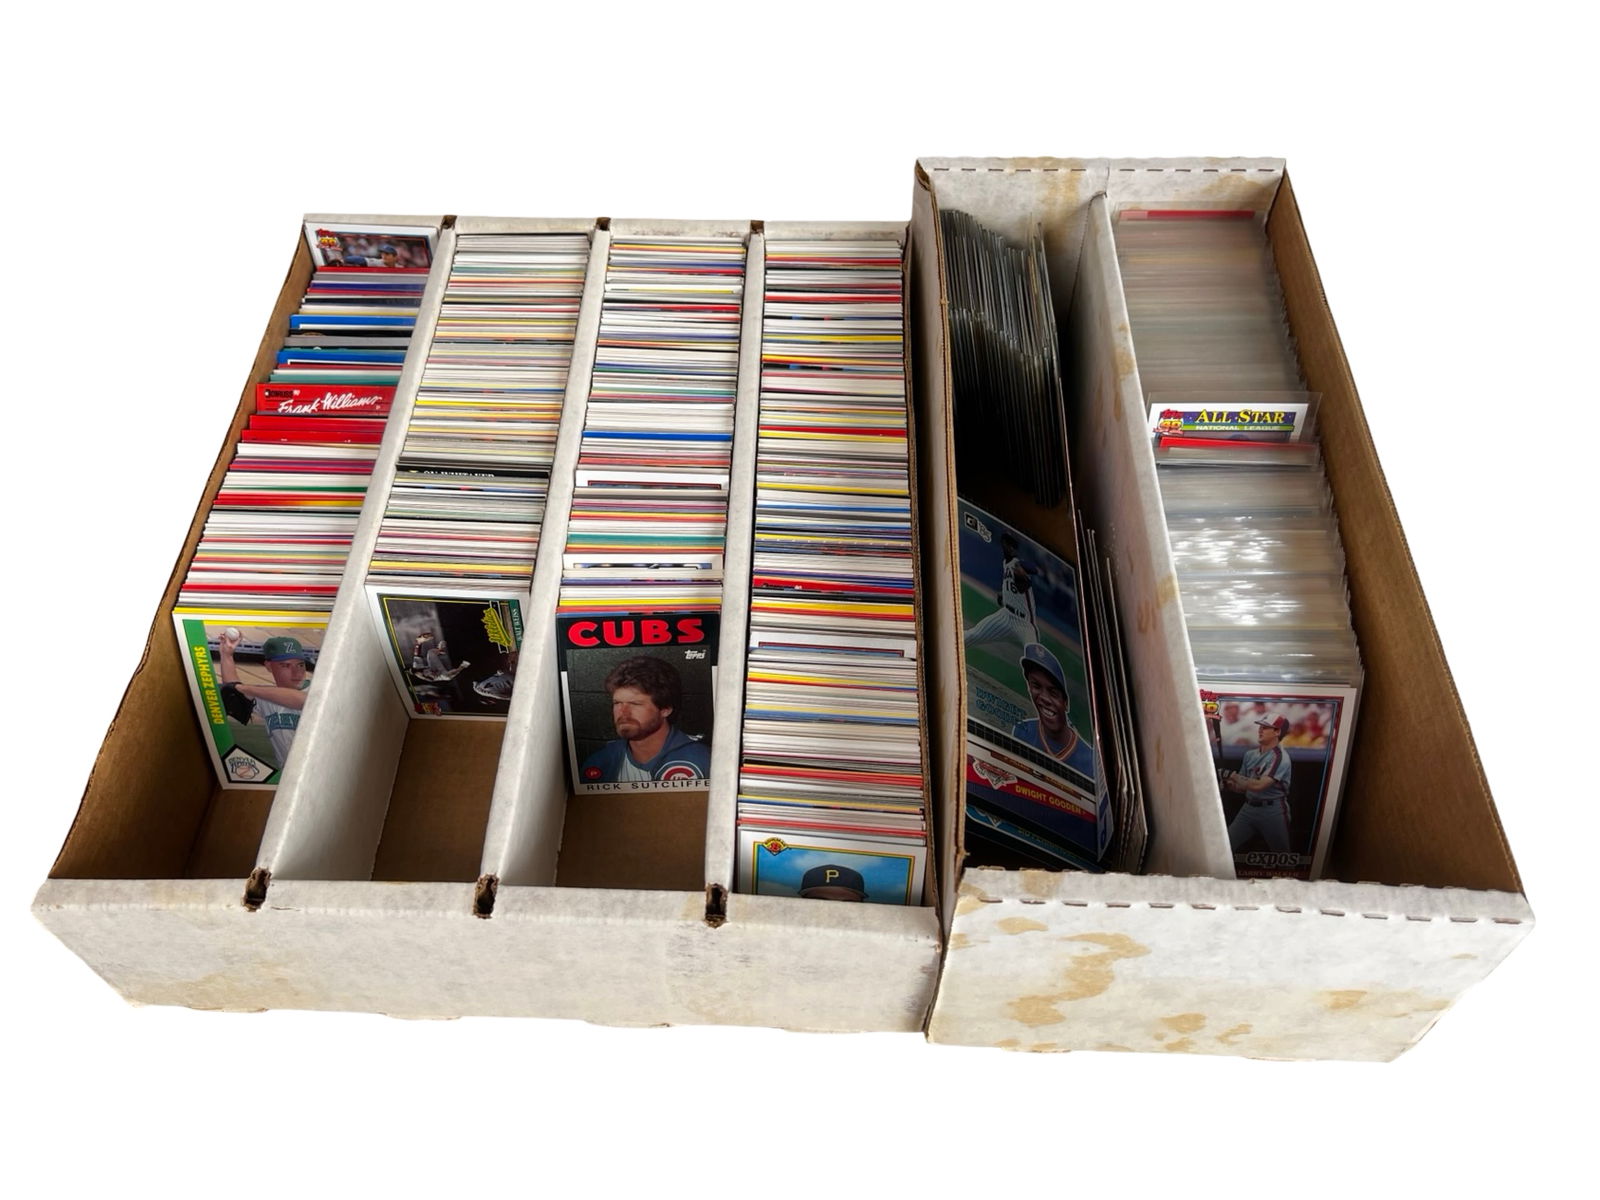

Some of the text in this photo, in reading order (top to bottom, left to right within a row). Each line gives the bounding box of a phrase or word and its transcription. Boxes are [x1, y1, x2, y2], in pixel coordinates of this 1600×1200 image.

[278, 392, 382, 413] Frank Williams
[1196, 409, 1286, 423] ALL STAR
[568, 618, 705, 647] CUBS
[194, 645, 225, 725] DENVER ZEPHYRS
[586, 779, 711, 791] RICK SUTCLIFFE
[1015, 784, 1081, 815] DWIGHT GOODEN
[1246, 851, 1300, 868] expos
[825, 869, 840, 883] P
